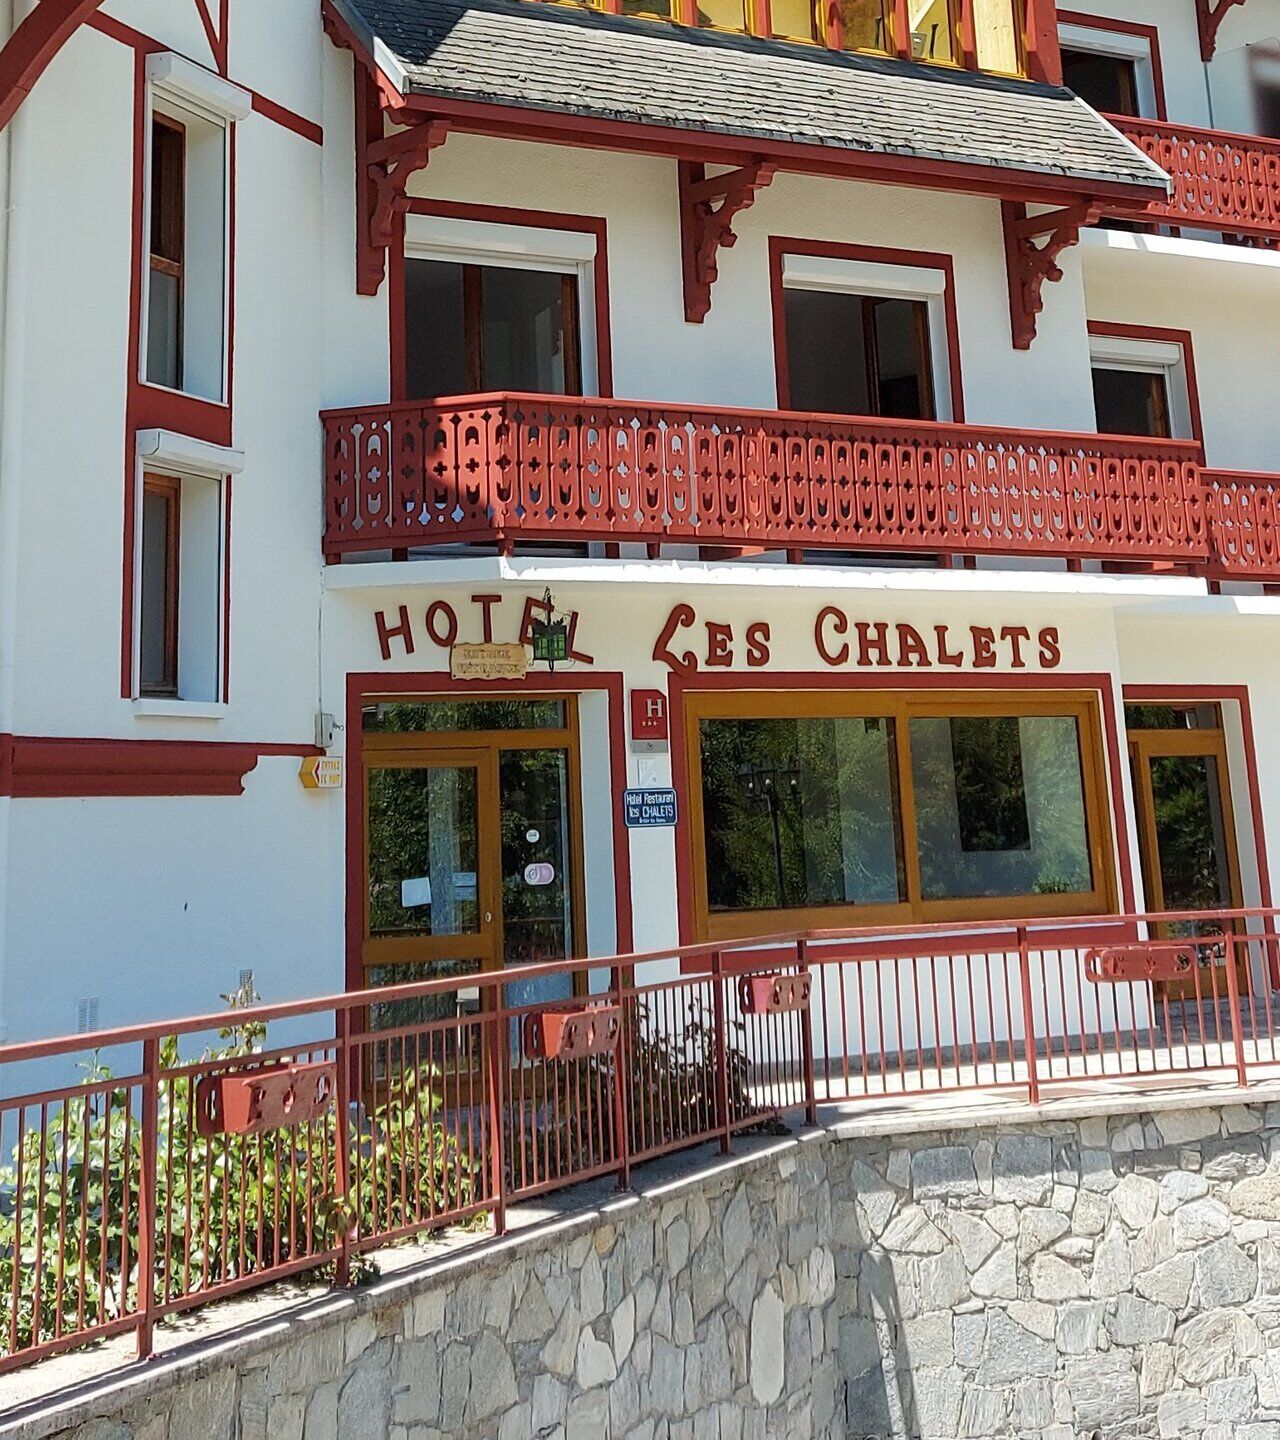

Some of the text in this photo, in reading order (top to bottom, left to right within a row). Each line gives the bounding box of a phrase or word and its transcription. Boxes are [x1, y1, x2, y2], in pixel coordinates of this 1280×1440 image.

[374, 594, 595, 665] HOTEL
[647, 698, 663, 718] H
[642, 805, 674, 818] CHALETS
